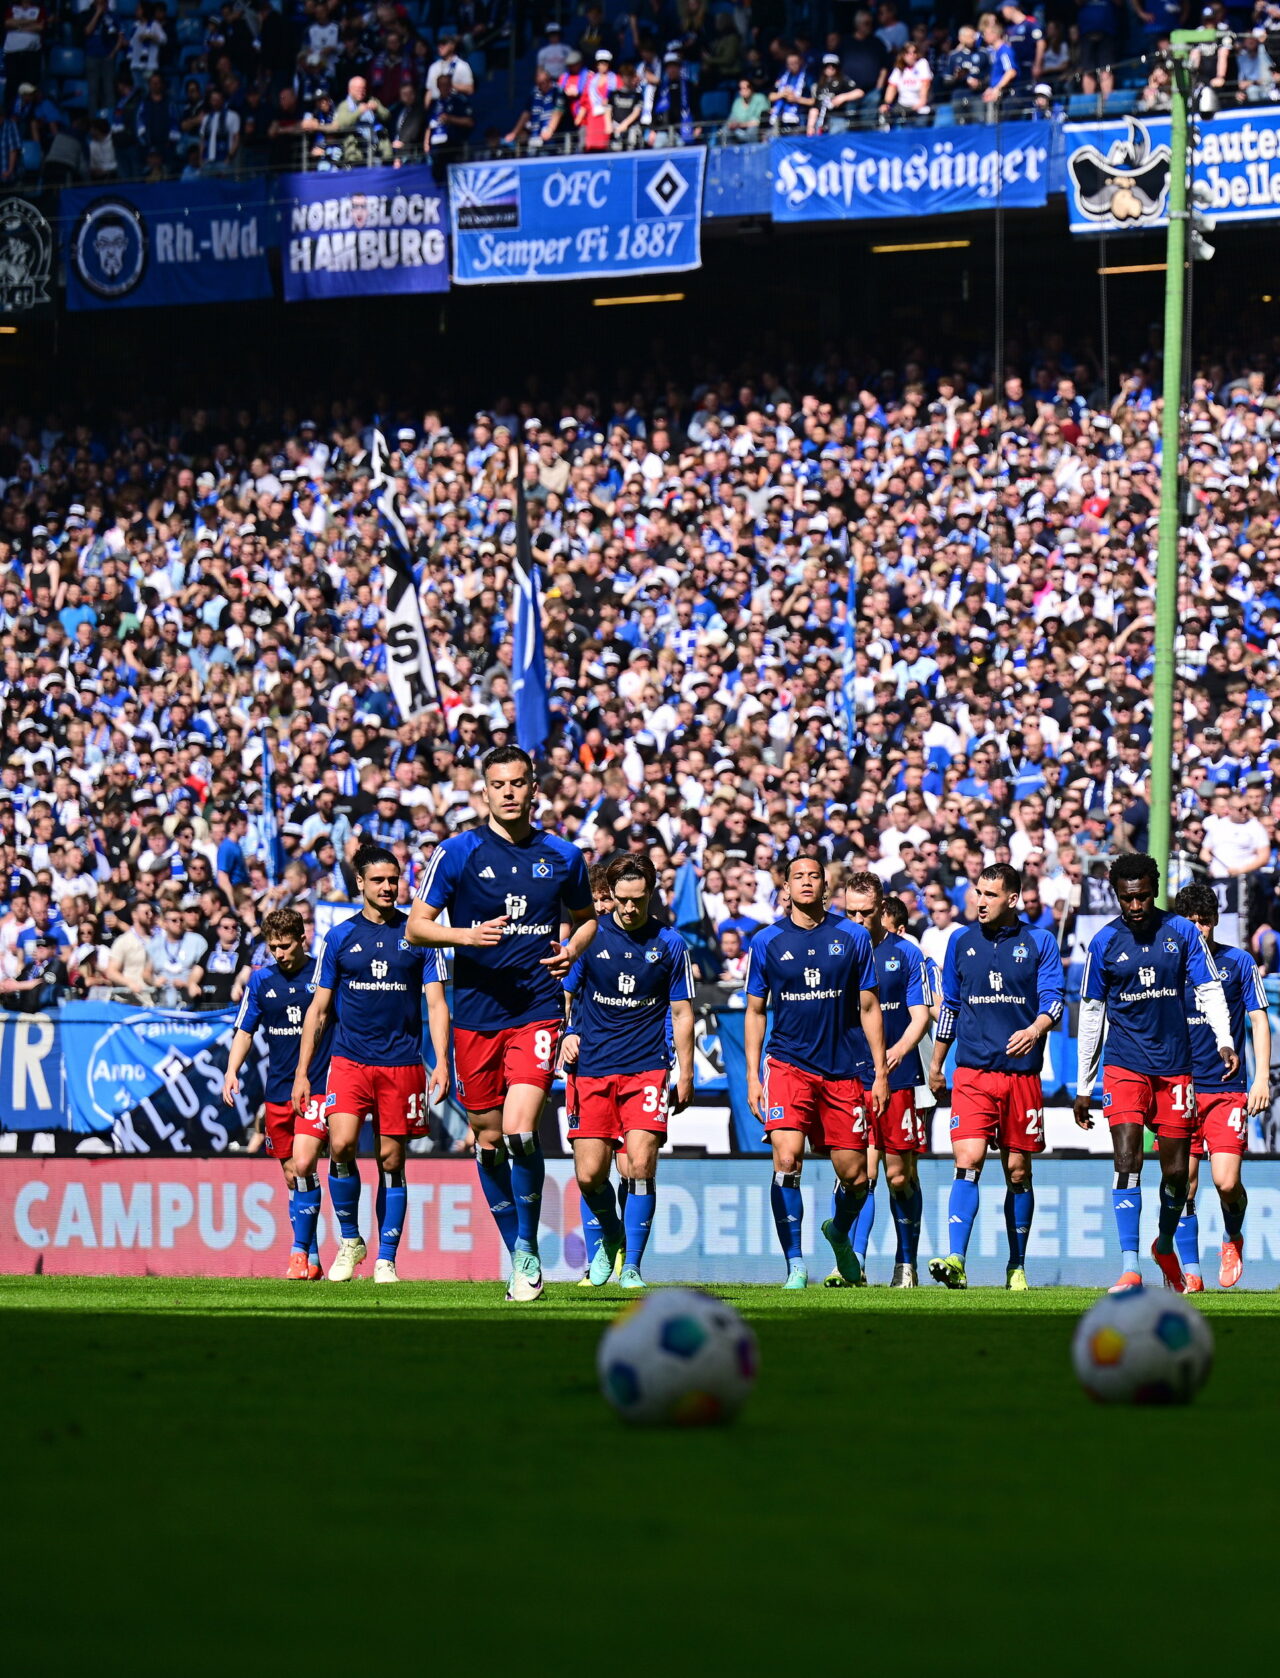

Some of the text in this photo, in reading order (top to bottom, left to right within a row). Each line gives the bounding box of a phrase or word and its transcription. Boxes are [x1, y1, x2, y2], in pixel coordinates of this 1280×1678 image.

[542, 169, 611, 209] OFC
[775, 141, 1048, 209] Hafensänger
[292, 197, 353, 233] NORD
[366, 193, 441, 228] BLOCK
[156, 216, 265, 264] Rh.-Wd.
[290, 228, 446, 273] HAMBURG
[472, 220, 685, 275] Semper Fi 1887
[348, 980, 407, 992] HanseMerku
[591, 991, 656, 1008] HanseMerkur
[968, 993, 1027, 1005] HanseMerkur
[533, 1029, 552, 1061] 8
[405, 1093, 427, 1119] 13
[641, 1085, 668, 1114] 33
[1167, 1083, 1193, 1111] 18
[853, 1105, 867, 1134] 2
[13, 1180, 474, 1253] CAMPUS UTE
[838, 1185, 1105, 1258] AFEE
